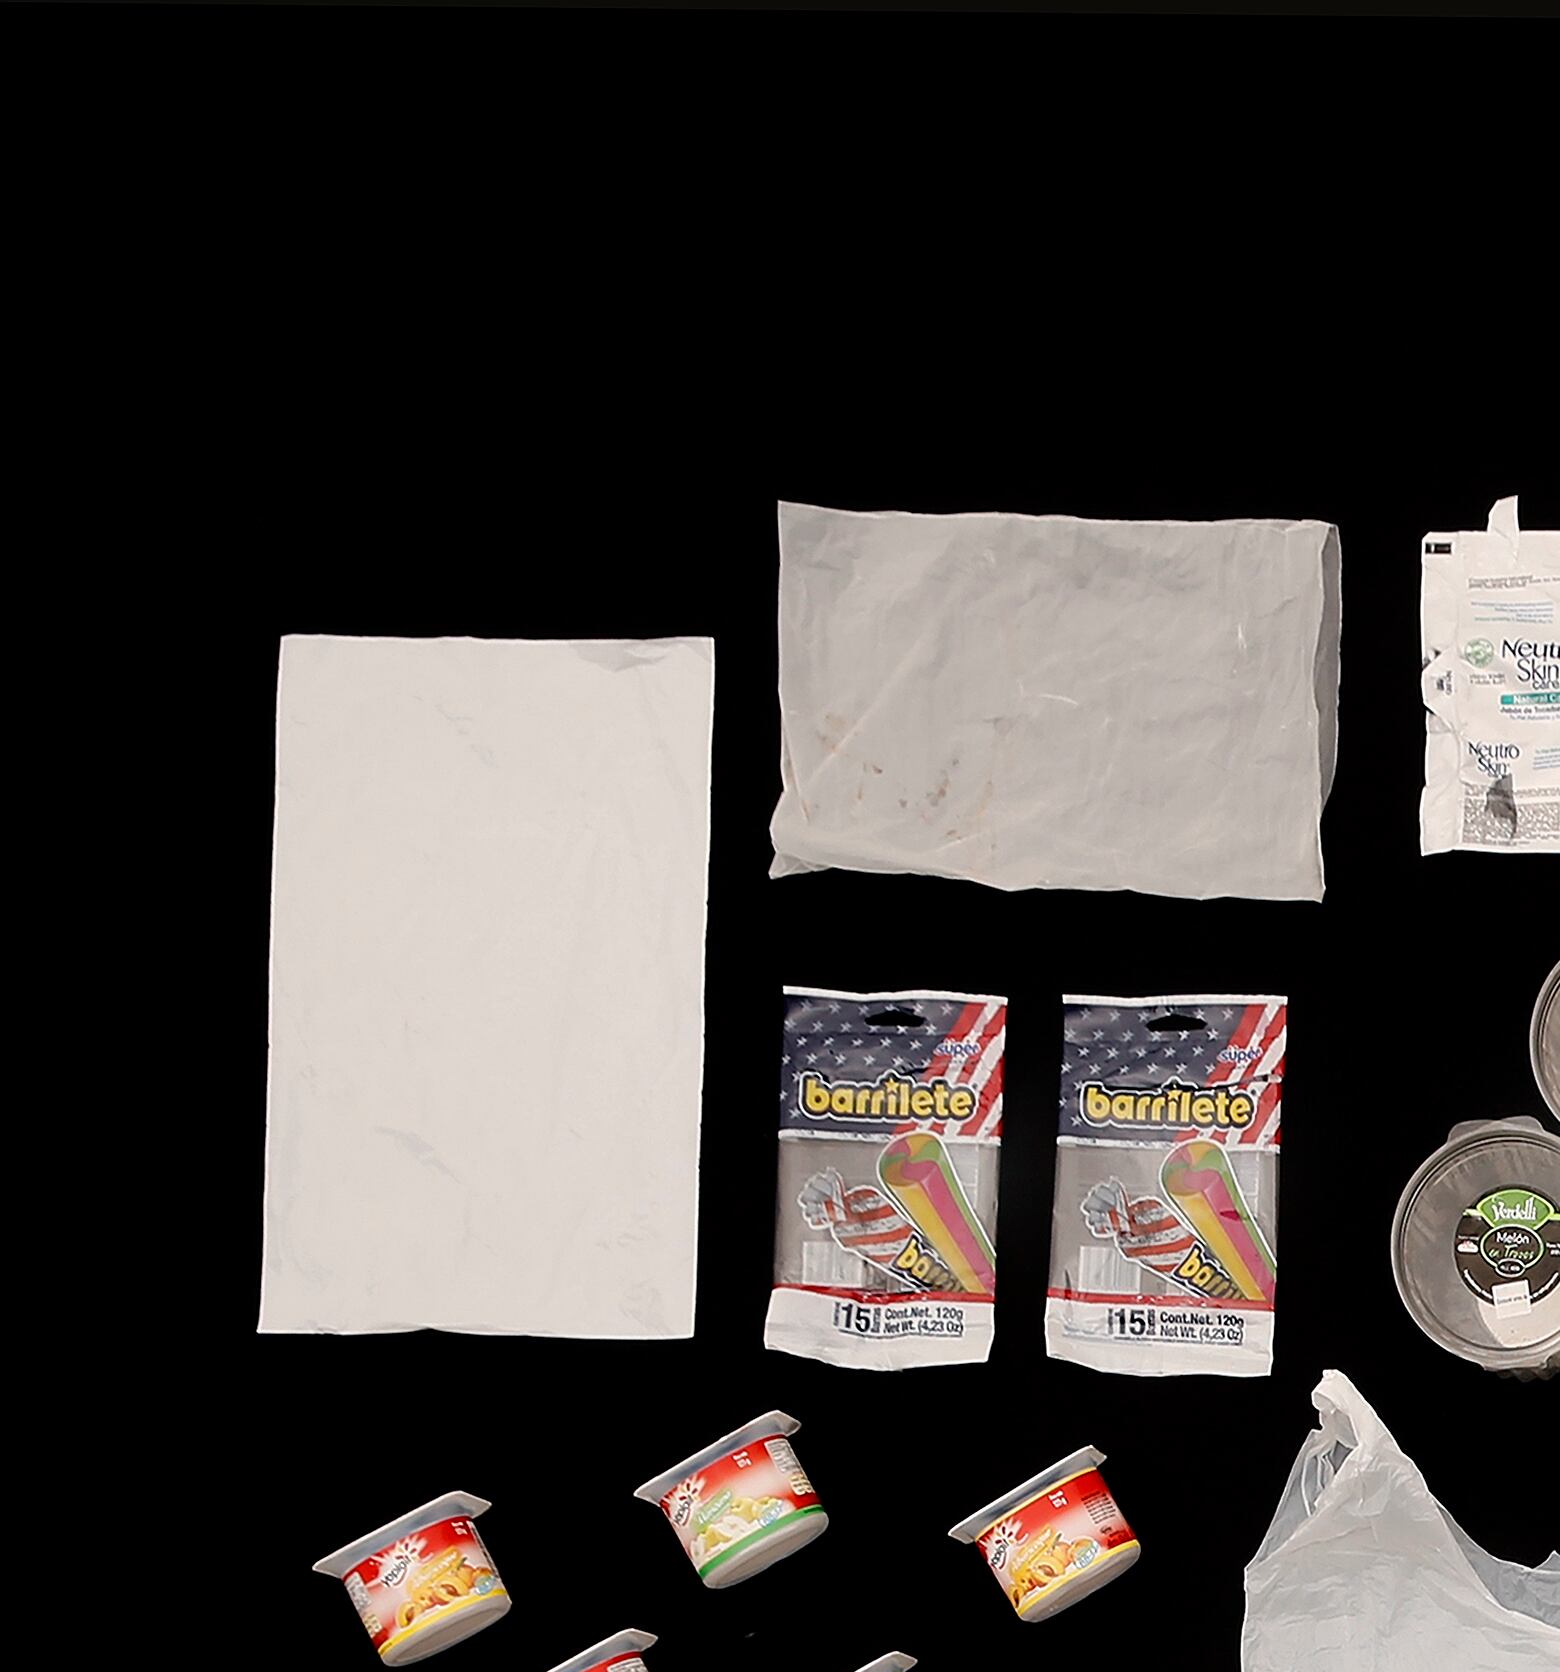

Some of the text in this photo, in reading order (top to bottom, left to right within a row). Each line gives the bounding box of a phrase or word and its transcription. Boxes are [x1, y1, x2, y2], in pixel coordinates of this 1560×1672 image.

[1517, 658, 1560, 682] Skin
[1468, 743, 1520, 759] Neutro
[804, 1078, 975, 1117] barrilete
[1086, 1085, 1254, 1124] barrilete
[841, 1304, 963, 1332] 15 120g
[1115, 1309, 1244, 1336] 15 120g
[1160, 1325, 1180, 1339] Net
